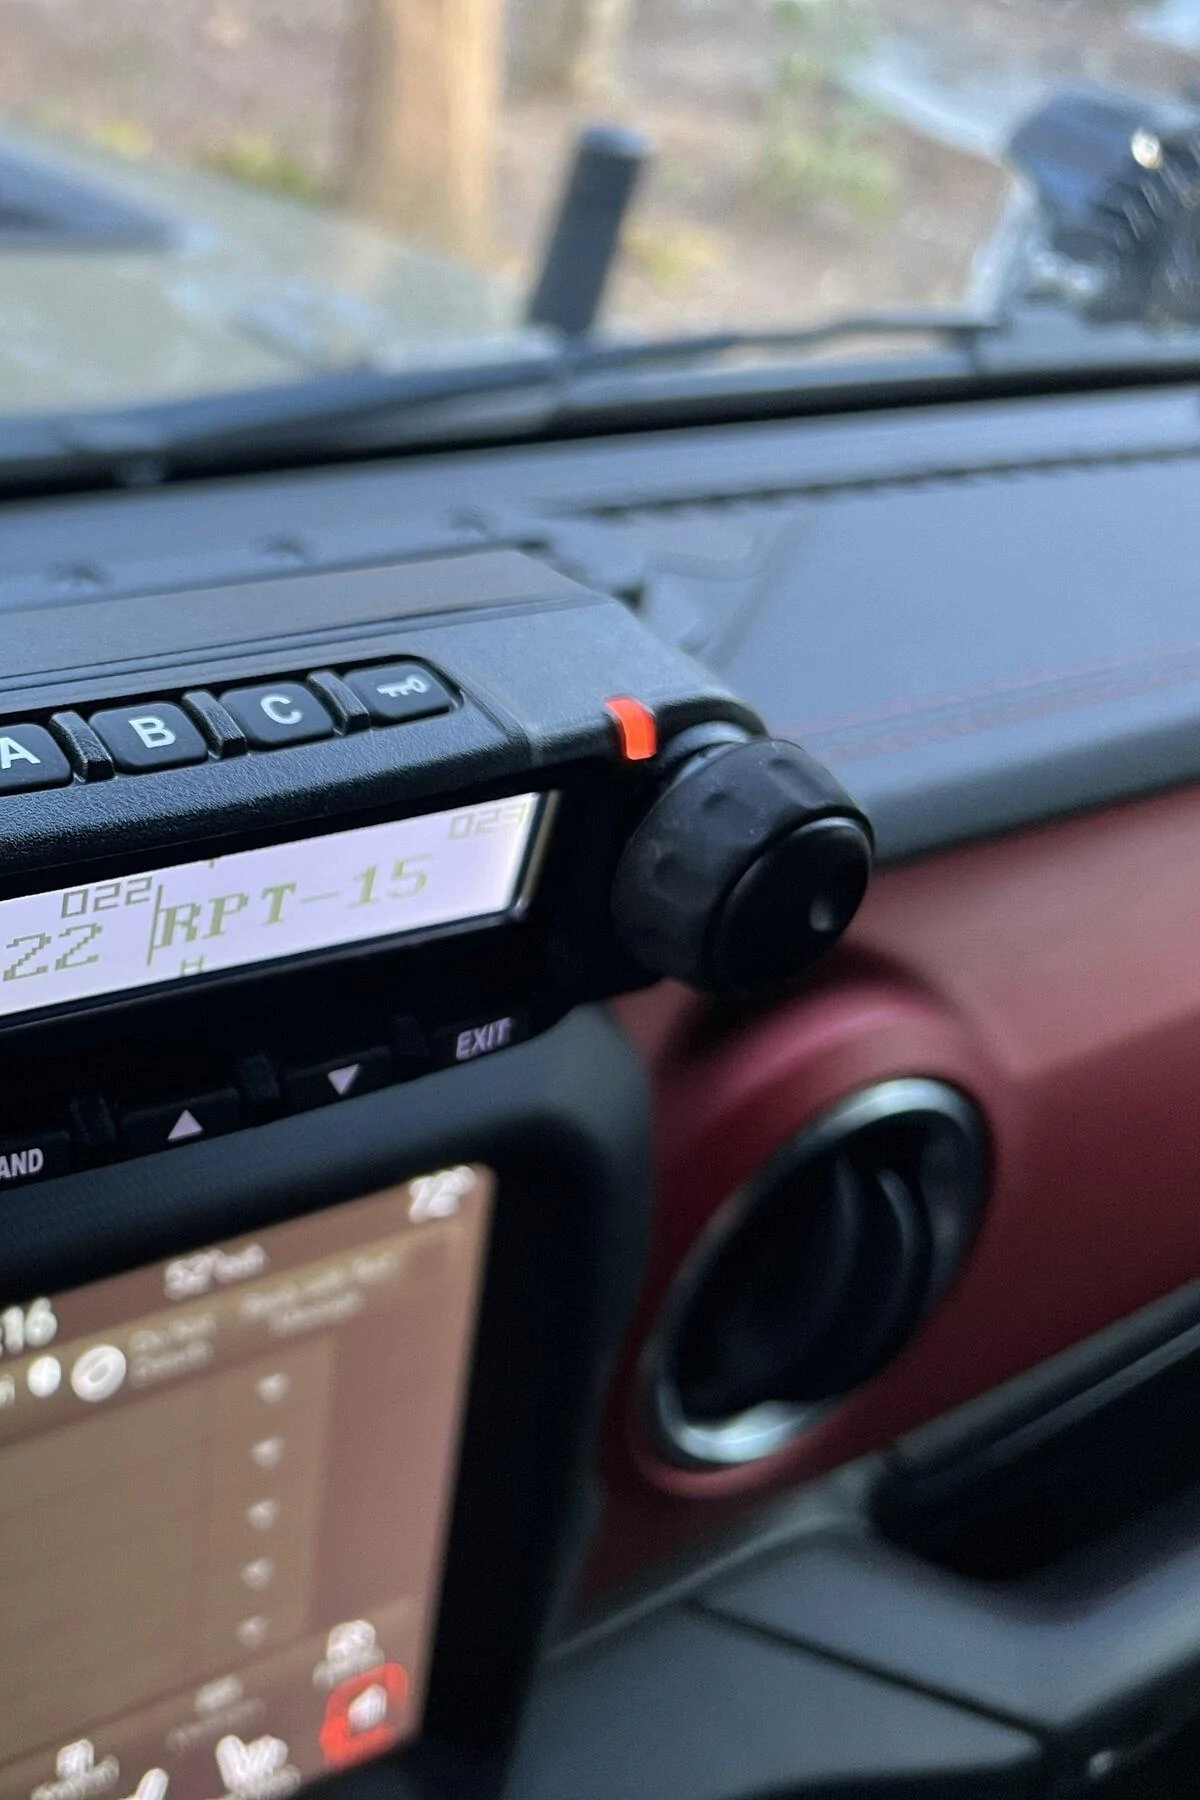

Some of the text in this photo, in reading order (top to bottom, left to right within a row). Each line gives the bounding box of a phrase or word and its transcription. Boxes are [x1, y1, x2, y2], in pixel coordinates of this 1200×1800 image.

[260, 694, 302, 725] C
[134, 716, 176, 750] B
[0, 736, 41, 769] A
[60, 876, 153, 919] 022
[155, 853, 434, 950] RPT-15
[455, 1016, 511, 1061] EXIT
